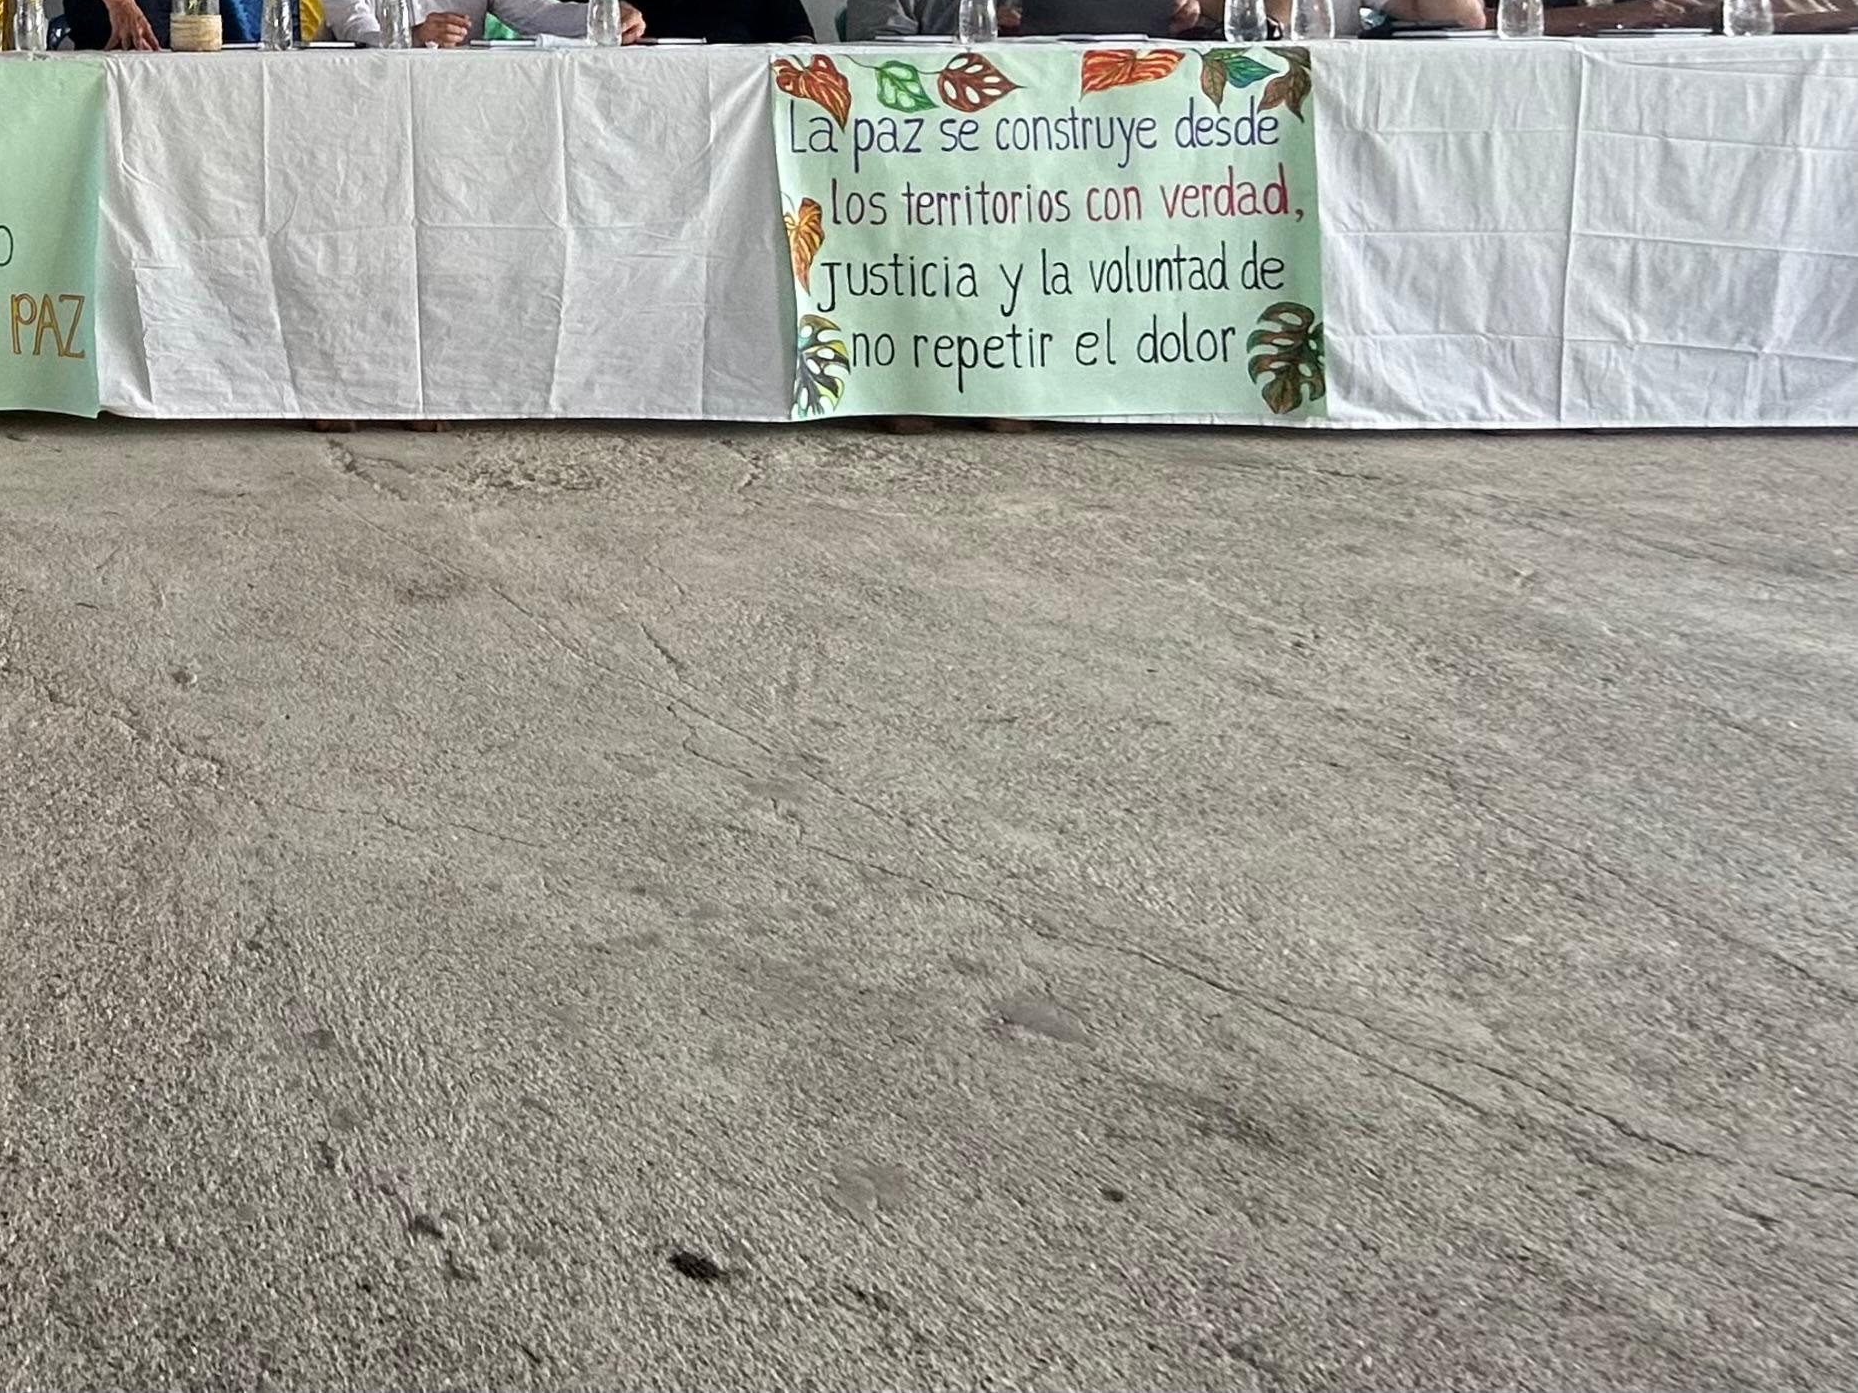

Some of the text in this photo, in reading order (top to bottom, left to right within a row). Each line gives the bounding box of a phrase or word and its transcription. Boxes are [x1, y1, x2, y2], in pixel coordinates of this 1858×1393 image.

[789, 96, 1280, 173] La paz se construye desde
[831, 163, 1305, 226] los territorios con verdad,
[1000, 261, 1024, 318] y
[1041, 248, 1072, 297] la
[1088, 240, 1229, 294] voluntad
[1241, 241, 1286, 292] de
[10, 292, 86, 359] PAZ
[851, 312, 1237, 393] no repetir el dolor
